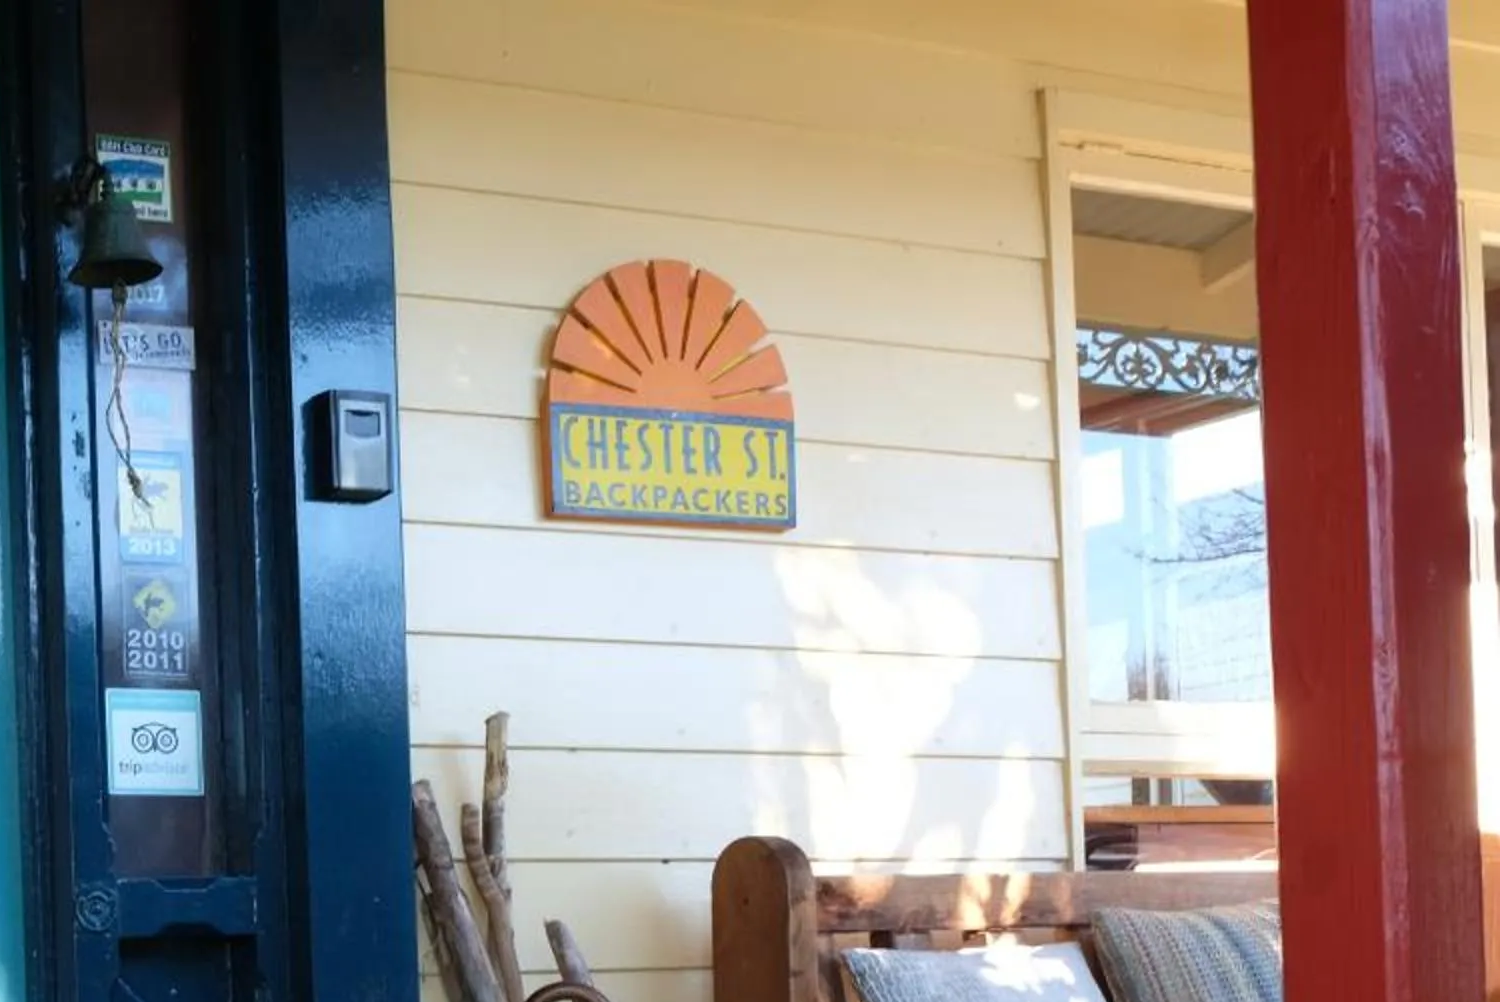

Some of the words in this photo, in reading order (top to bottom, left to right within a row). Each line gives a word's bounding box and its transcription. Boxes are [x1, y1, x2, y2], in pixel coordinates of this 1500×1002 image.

[157, 332, 182, 350] GO
[562, 416, 722, 477] CHESTER
[742, 429, 786, 481] ST.
[564, 480, 787, 516] BACKPACKERS
[127, 629, 184, 650] 2010
[127, 651, 184, 670] 2011
